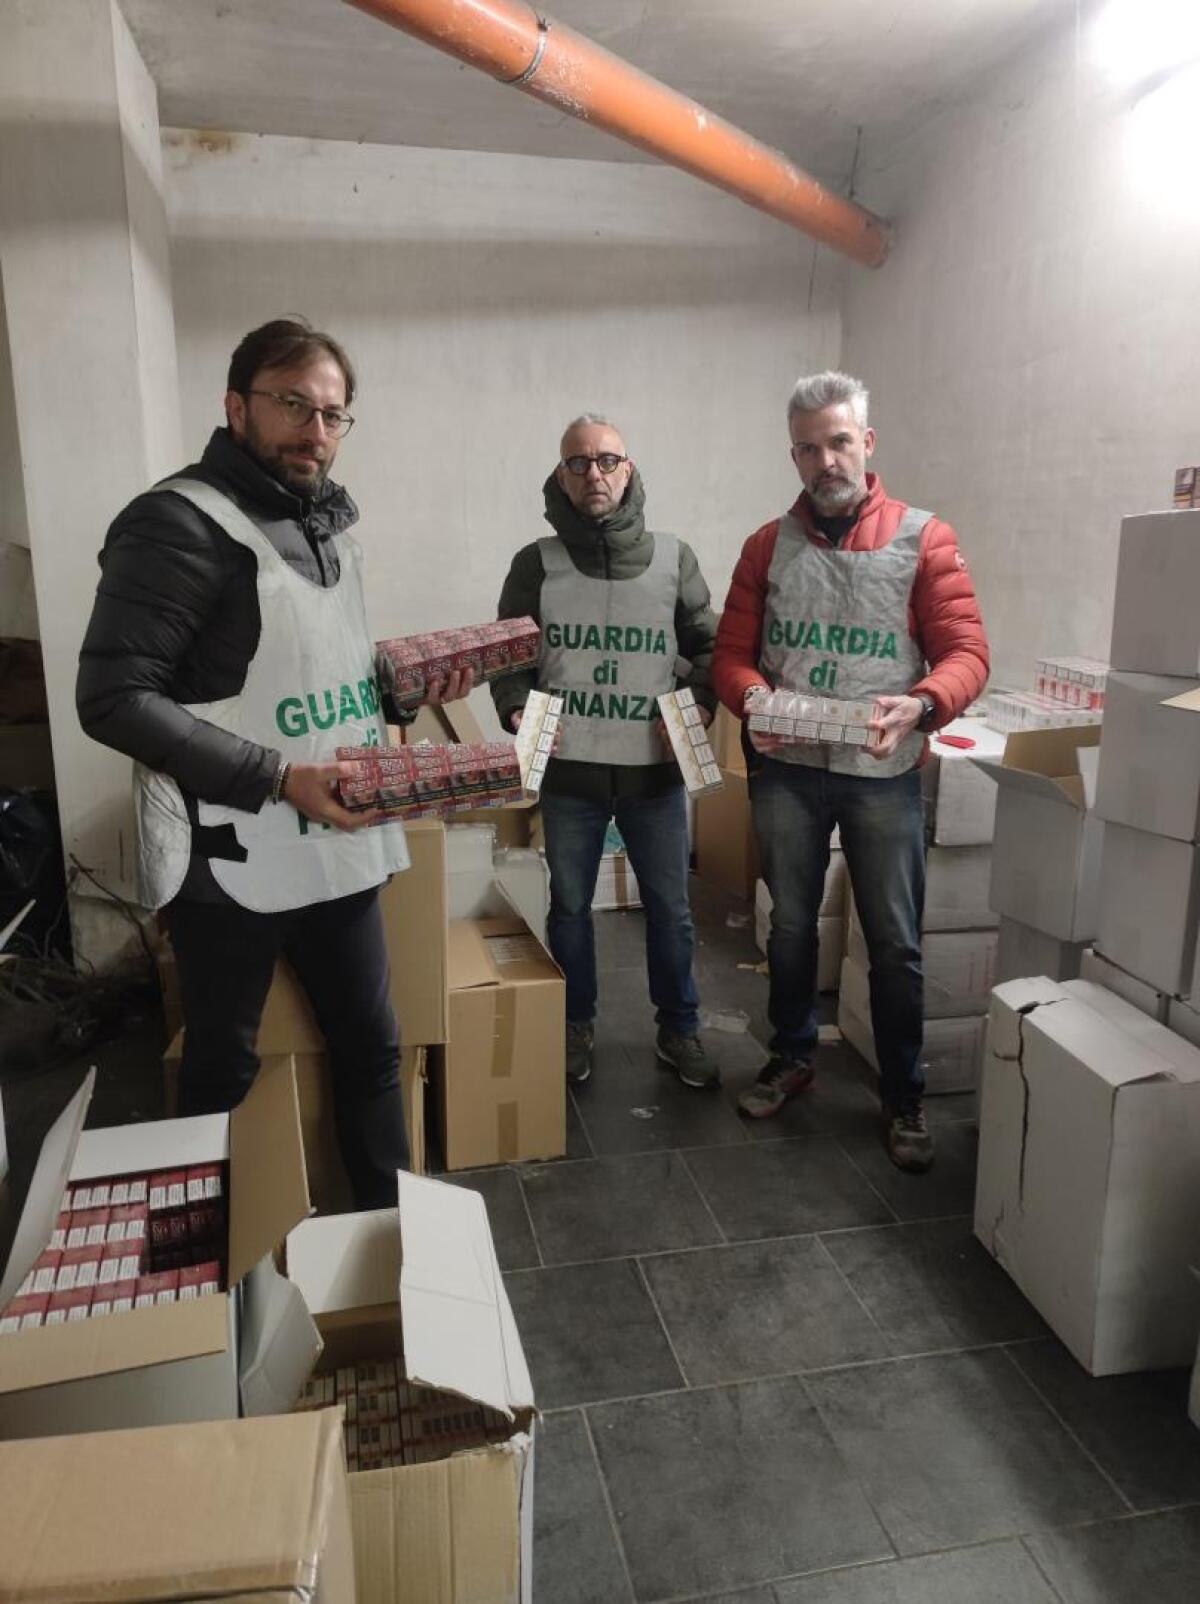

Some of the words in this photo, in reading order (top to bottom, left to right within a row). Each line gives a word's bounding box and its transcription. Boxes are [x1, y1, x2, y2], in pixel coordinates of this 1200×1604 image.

[546, 623, 667, 655] GUARDIA
[768, 618, 897, 659] GUARDIA
[593, 659, 618, 685] di
[809, 661, 838, 689] di
